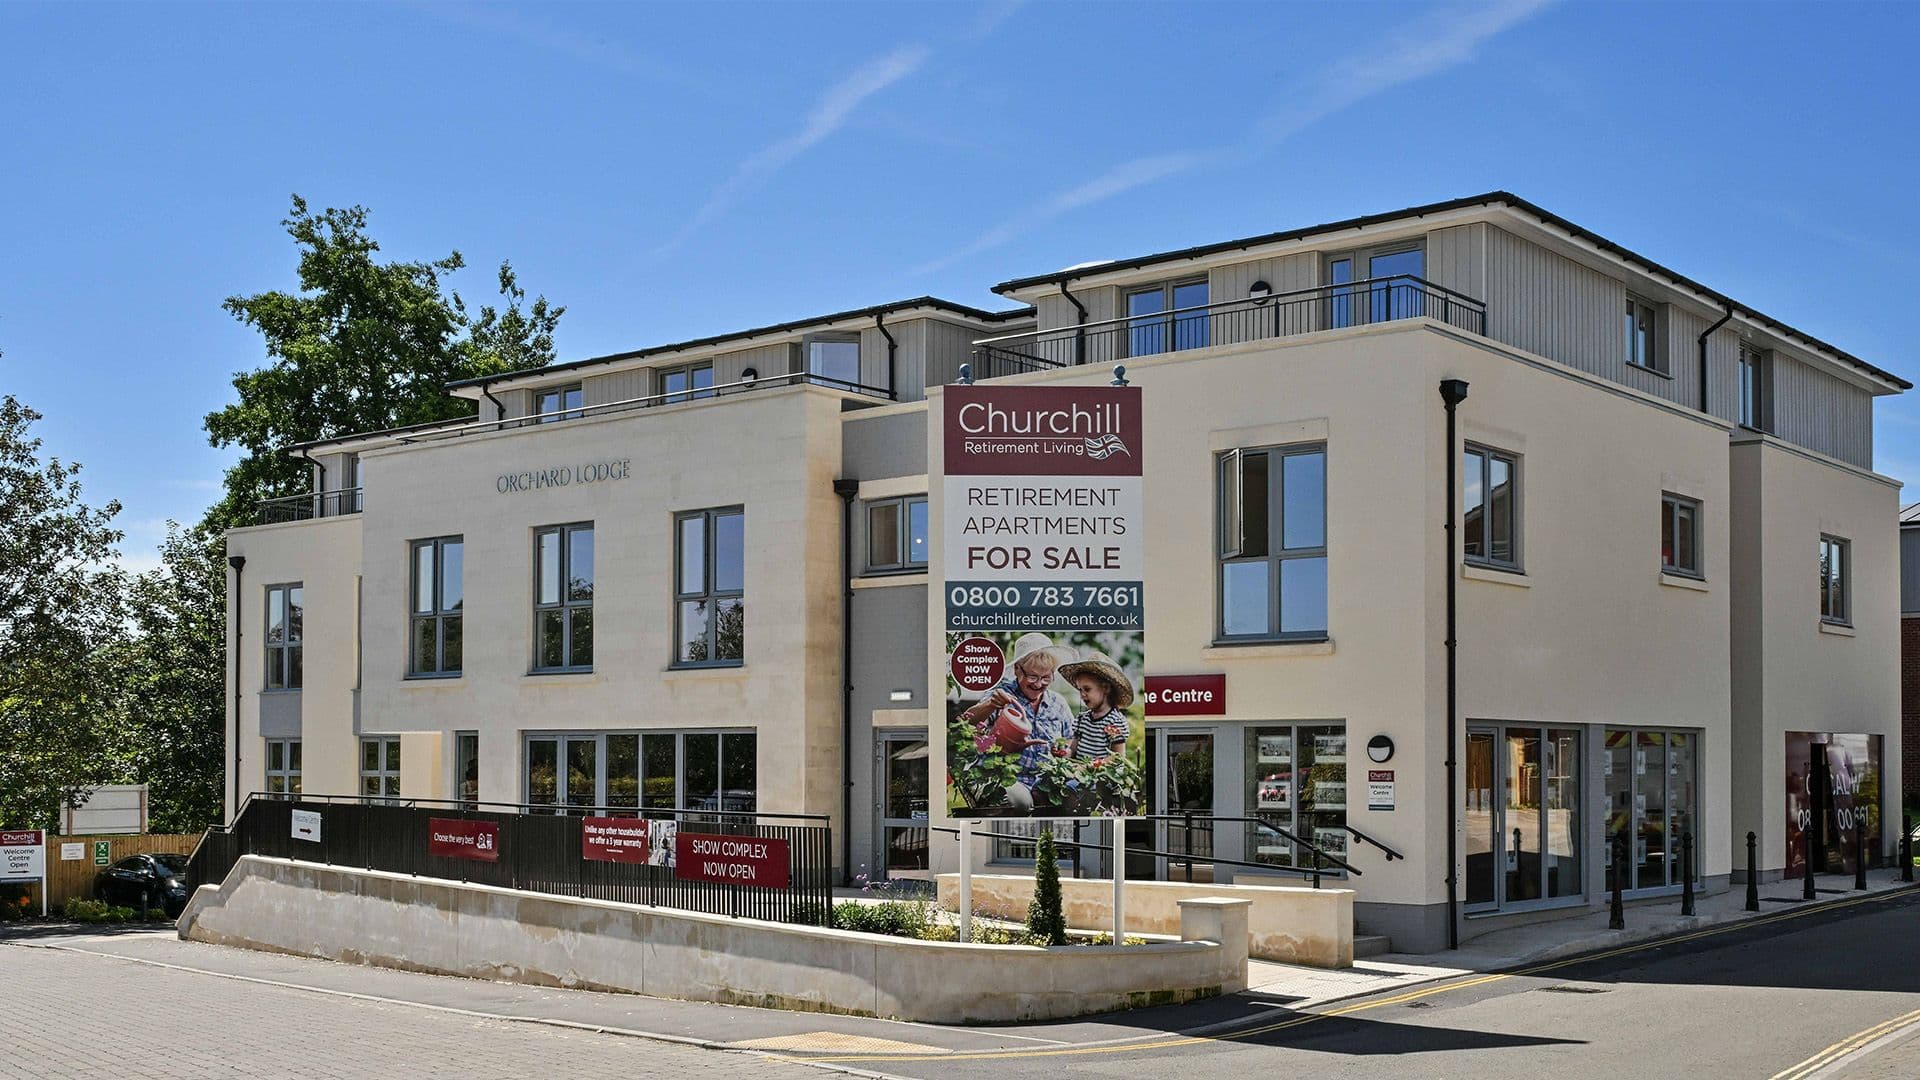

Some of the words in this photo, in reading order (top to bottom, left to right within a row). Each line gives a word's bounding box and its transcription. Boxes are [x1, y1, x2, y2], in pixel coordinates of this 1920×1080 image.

[958, 402, 1120, 434] Churchill
[964, 441, 1039, 454] Retirement
[1044, 441, 1084, 456] Living
[496, 465, 571, 494] ORCHARD
[576, 458, 631, 484] LODGE
[968, 488, 1121, 506] RETIREMENT
[963, 516, 1126, 535] APARTMENTS
[968, 546, 1032, 570] FOR
[1043, 546, 1121, 570] SALE
[950, 586, 1021, 607] 0800
[1029, 586, 1074, 607] 783
[1084, 586, 1138, 607] 7661
[951, 612, 1138, 627] churchillretirement.co.uk
[964, 644, 991, 653] Show
[957, 655, 999, 665] Complex
[965, 665, 991, 674] NOW
[964, 675, 992, 684] OPEN
[1161, 688, 1213, 703] Centre
[2, 833, 35, 841] Churchill
[585, 825, 598, 833] Unlike
[606, 827, 617, 835] other
[433, 832, 448, 842] Choose
[448, 833, 456, 843] the
[456, 836, 464, 845] very
[465, 835, 474, 845] best
[595, 836, 605, 844] offer
[613, 839, 623, 847] year
[624, 840, 642, 849] warranty
[692, 839, 720, 855] SHOW
[722, 841, 768, 859] COMPLEX
[703, 861, 727, 877] NOW
[728, 863, 756, 879] OPEN
